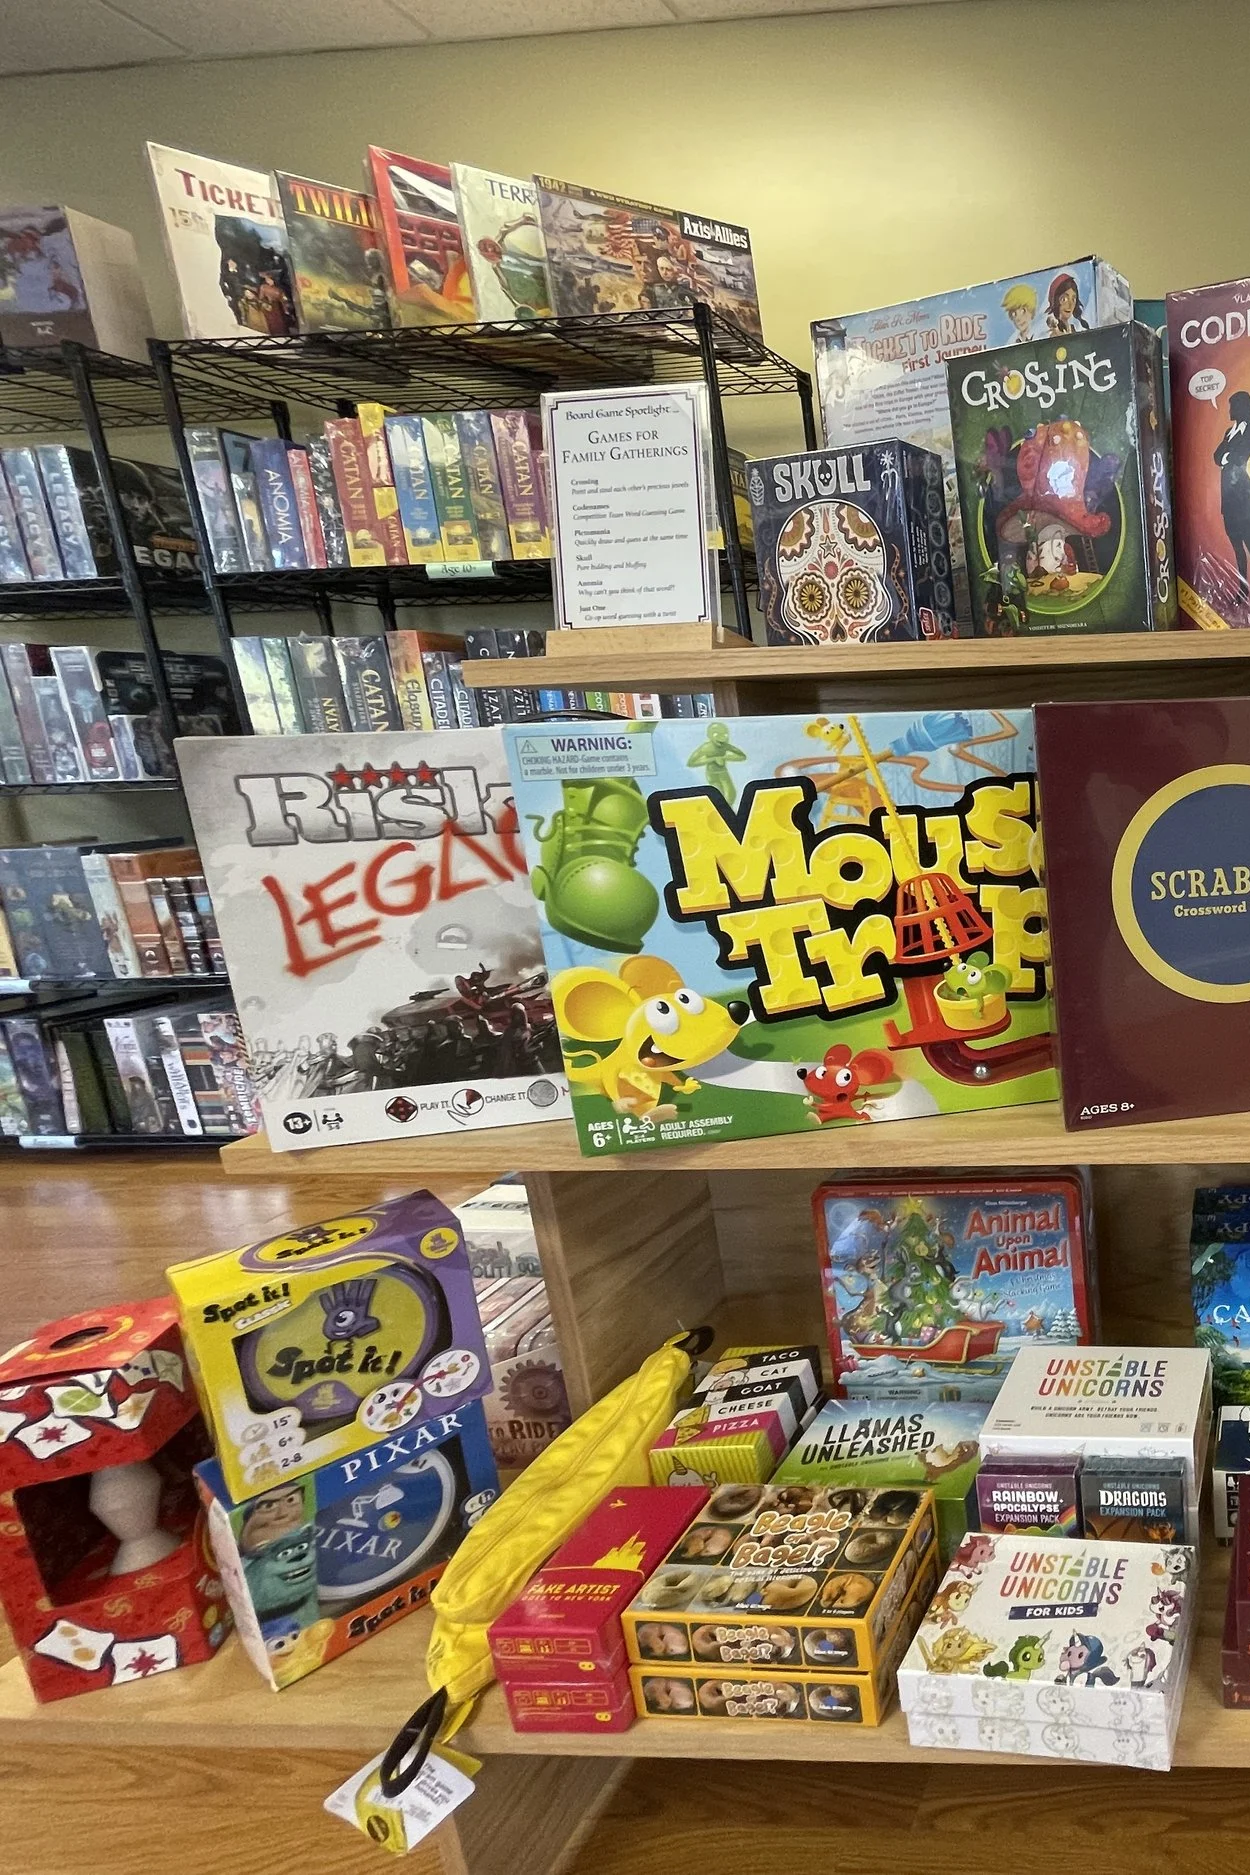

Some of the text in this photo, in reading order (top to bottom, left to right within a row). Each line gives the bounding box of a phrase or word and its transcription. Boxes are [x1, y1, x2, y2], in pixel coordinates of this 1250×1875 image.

[683, 216, 749, 249] Axis Allies
[920, 330, 939, 351] TO
[939, 313, 988, 346] RIDE
[961, 346, 1118, 412] CROSSING
[1195, 381, 1220, 395] SECRET
[1199, 374, 1214, 384] TOP
[565, 408, 594, 421] Board
[595, 408, 624, 419] Game
[588, 430, 633, 444] GAMES
[562, 445, 688, 464] FAMILY GATHERINGS
[340, 440, 365, 500] CATAN
[443, 443, 467, 499] CATAN
[473, 440, 495, 495] CATAN
[511, 440, 534, 498] CATAN
[772, 453, 872, 502] SKULL
[263, 468, 294, 545] ANOMIA
[1150, 450, 1172, 605] CROSSING
[441, 563, 460, 575] Age
[551, 736, 632, 752] WARNING:
[1173, 900, 1247, 917] Crossword
[420, 1102, 440, 1112] PLAY
[485, 1093, 516, 1104] CHANGE
[1080, 1101, 1135, 1117] AGES 8+
[659, 1115, 734, 1133] ADULT ASSEMBLY
[588, 1121, 614, 1148] AGES 6+
[660, 1128, 706, 1141] REQUIRED.
[964, 1203, 1061, 1241] Animal
[276, 1238, 325, 1260] Spot
[996, 1233, 1032, 1250] Upon
[972, 1239, 1070, 1280] Animal
[203, 1282, 290, 1326] Spot it!
[267, 1344, 402, 1385] Spot it!
[761, 1350, 800, 1362] TACO
[1046, 1353, 1169, 1378] UNSTABLE
[760, 1366, 788, 1378] CAT
[740, 1381, 783, 1396] GOAT
[1038, 1378, 1165, 1398] UNICORNS
[717, 1399, 773, 1416] CHEESE
[712, 1417, 761, 1433] PIZZA
[823, 1413, 925, 1445] LLAMAS
[278, 1435, 294, 1447] 6+
[343, 1411, 464, 1484] PIXAR
[800, 1430, 936, 1466] UNLEASHED
[991, 1489, 1059, 1503] RAINBOW
[1099, 1489, 1167, 1508] DRAGONS
[993, 1503, 1060, 1513] APOCALYPSE
[1099, 1506, 1167, 1518] EXPANSION PACK
[750, 1509, 851, 1537] Beagle
[995, 1513, 1060, 1524] EXPANSION PACK
[729, 1537, 840, 1570] Bagel?
[1010, 1549, 1129, 1580] UNSTABLE
[528, 1583, 621, 1595] FAKE ARTIST
[999, 1575, 1122, 1605] UNICORNS
[347, 1601, 397, 1638] Spot
[1026, 1605, 1084, 1617] FOR KIDS
[715, 1627, 770, 1642] Beagle
[721, 1682, 774, 1698] Beagle
